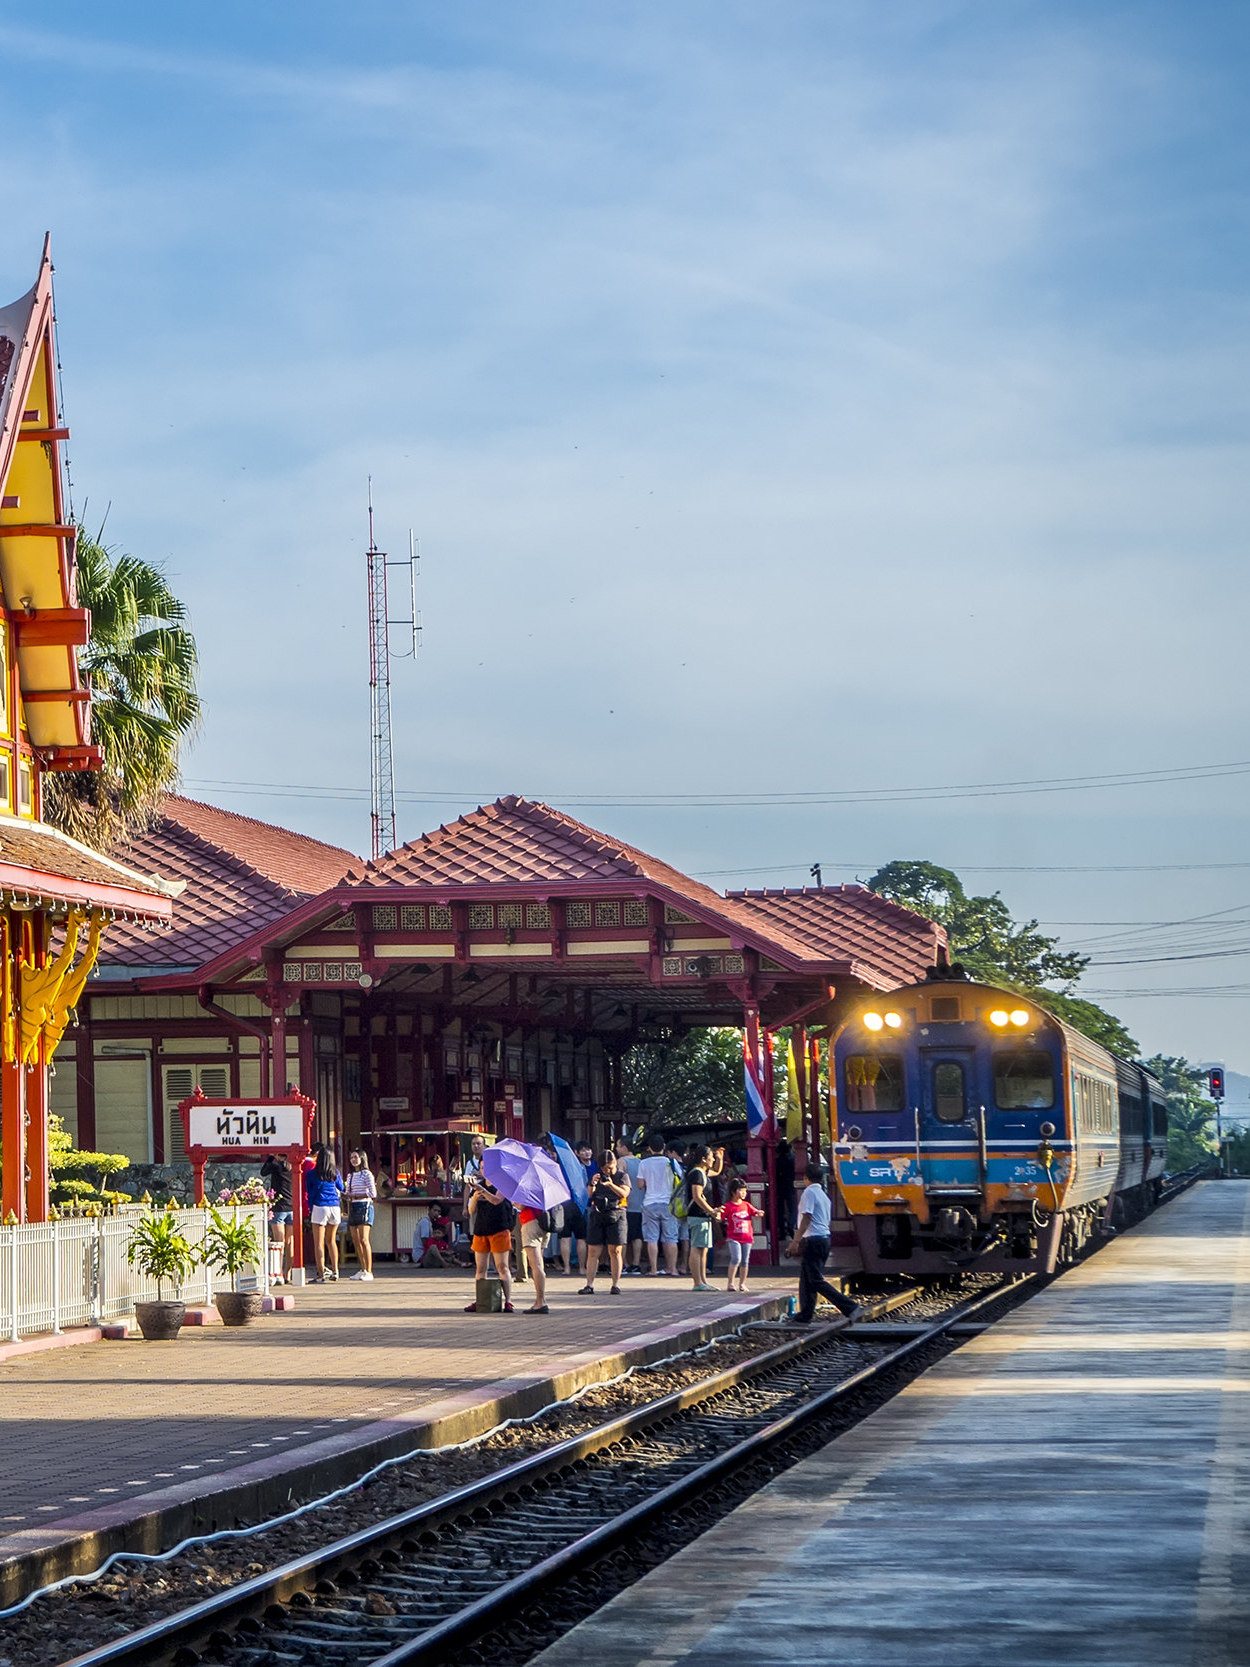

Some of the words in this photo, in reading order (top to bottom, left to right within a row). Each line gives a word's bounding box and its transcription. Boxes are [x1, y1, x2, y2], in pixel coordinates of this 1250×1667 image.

[216, 1108, 277, 1135] หัวหิน
[222, 1137, 241, 1145] HUA
[1014, 1165, 1037, 1176] 235
